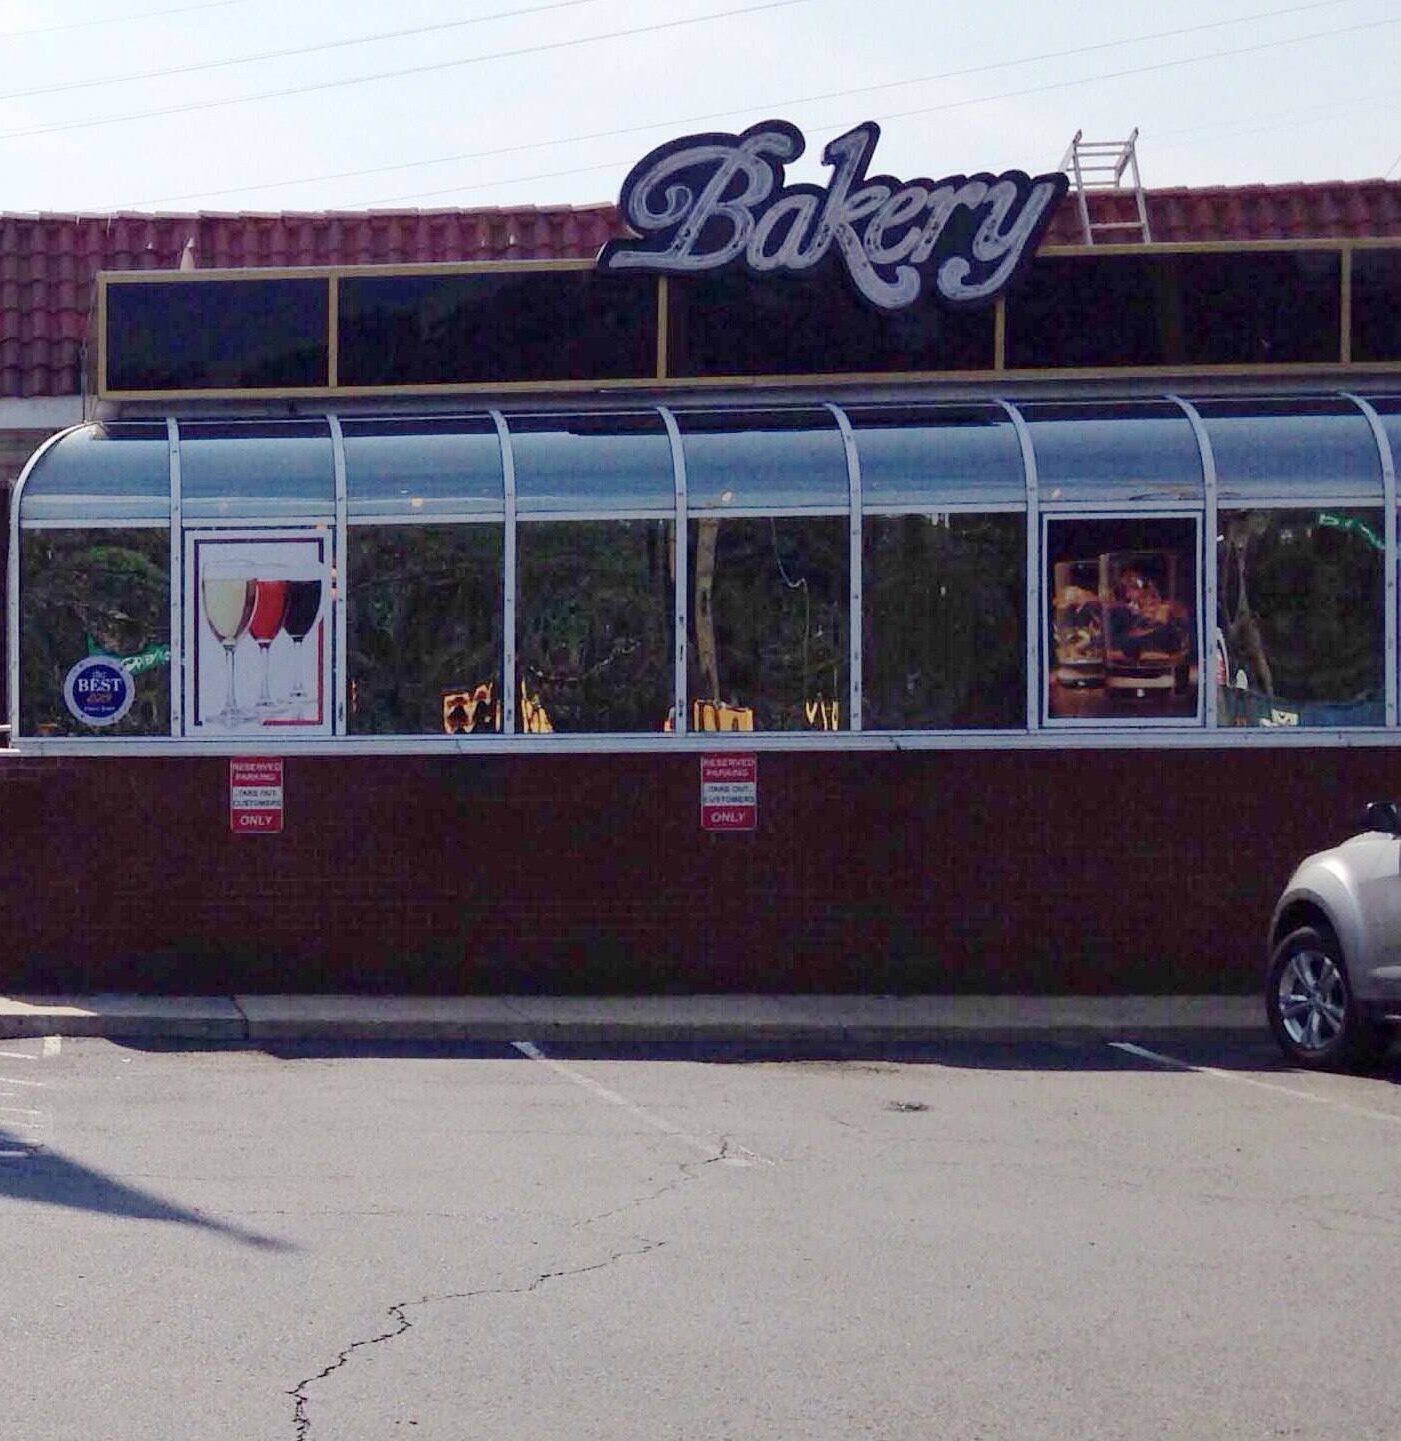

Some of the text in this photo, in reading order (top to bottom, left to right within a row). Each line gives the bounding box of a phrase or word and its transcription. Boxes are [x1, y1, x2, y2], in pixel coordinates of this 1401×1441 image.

[605, 120, 1058, 310] Bakery
[78, 678, 122, 692] BEST
[231, 762, 281, 771] RESERVED
[703, 759, 754, 767] RESERVED
[240, 815, 273, 826] ONLY
[710, 811, 746, 823] ONLY
